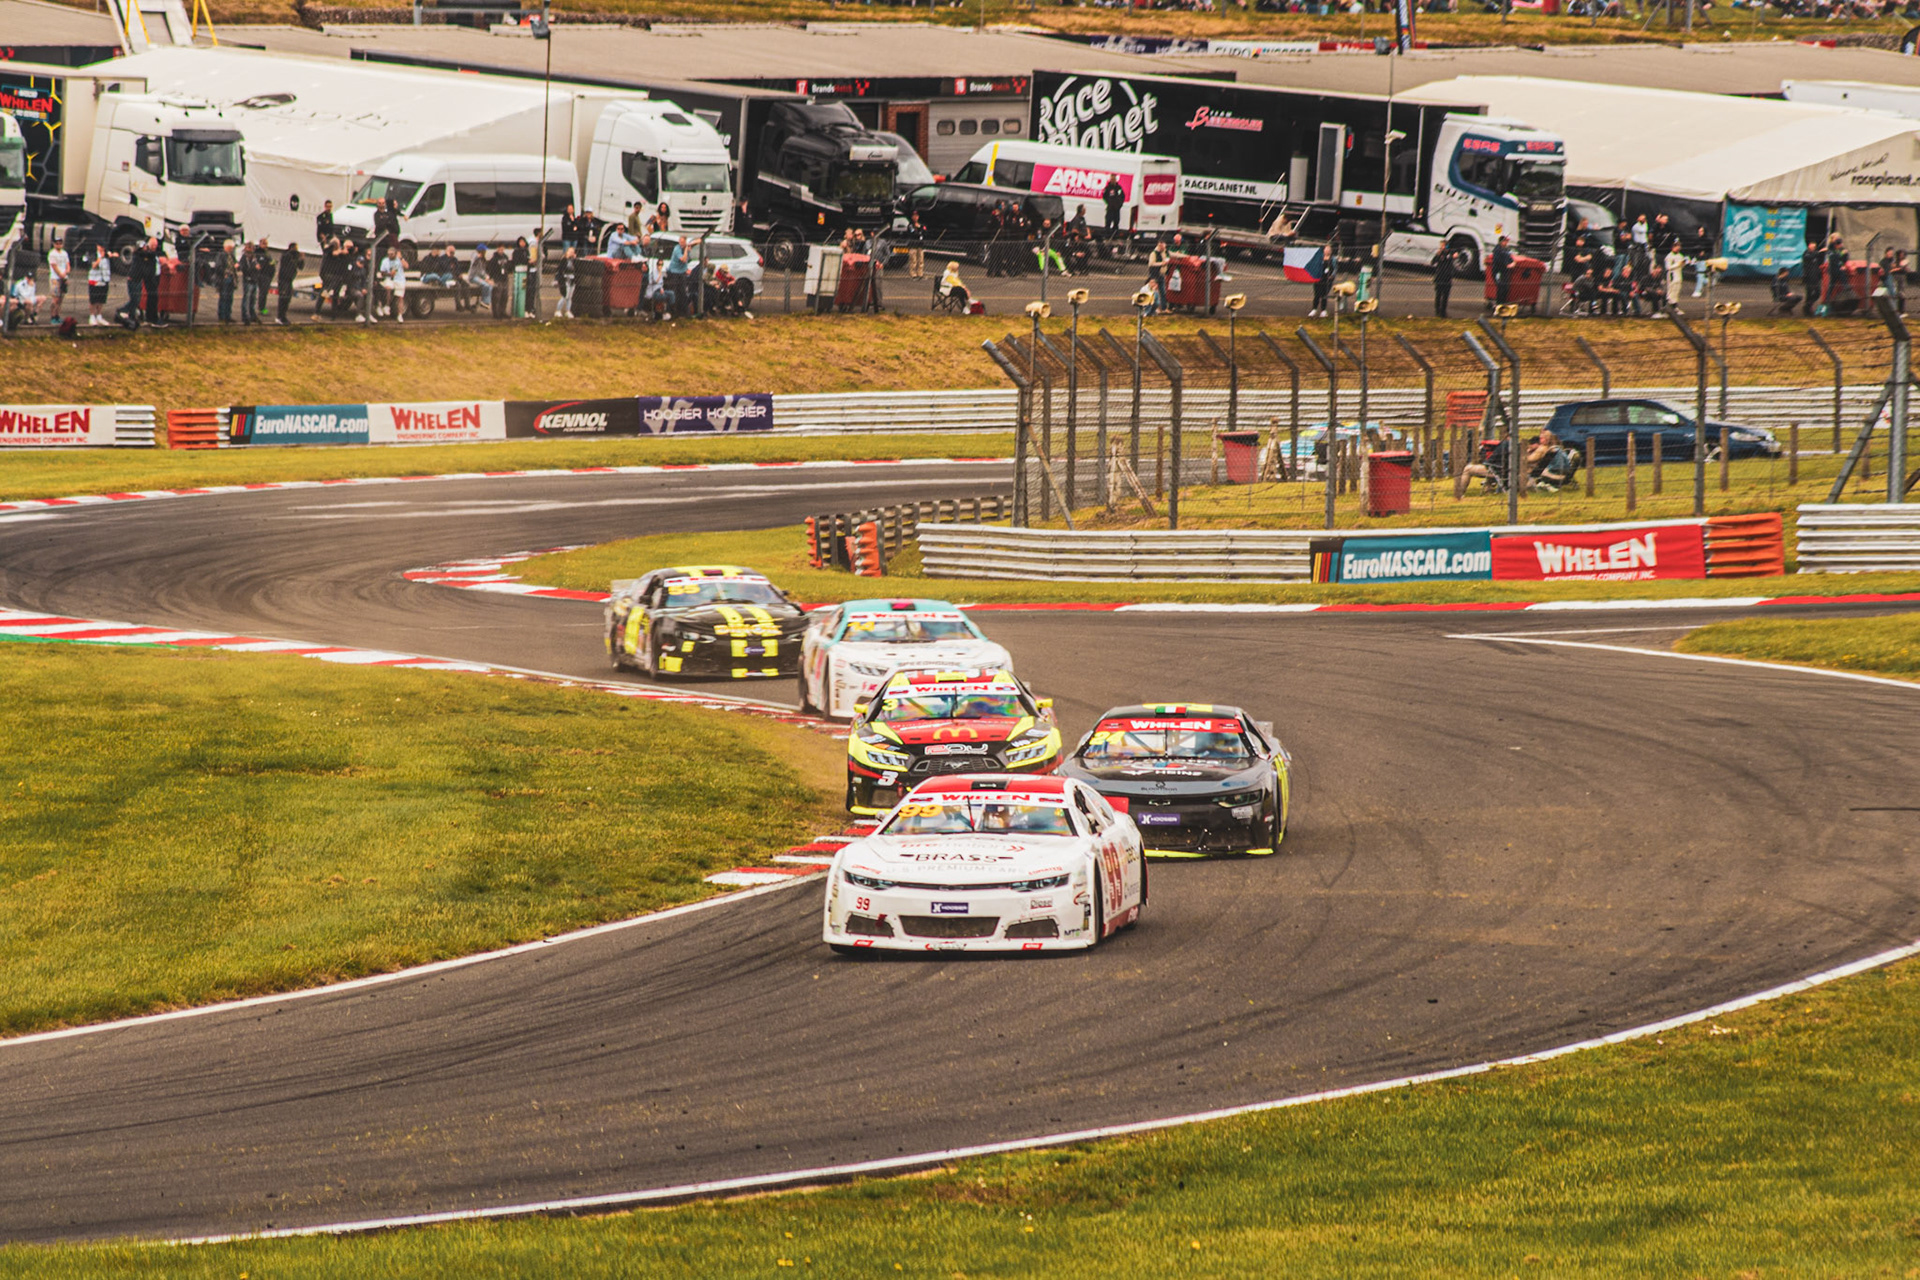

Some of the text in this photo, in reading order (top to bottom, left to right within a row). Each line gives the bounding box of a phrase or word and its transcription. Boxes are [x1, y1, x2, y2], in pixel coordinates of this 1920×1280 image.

[1038, 79, 1112, 142] Race
[1184, 179, 1258, 195] RACEPLANET.NL
[390, 404, 481, 430] WHELEN
[644, 408, 702, 421] HOOSIER
[706, 405, 767, 419] HOOSIER
[0, 408, 90, 433] WHELEN
[255, 414, 368, 434] EuroNASCAR.com
[538, 412, 608, 429] KENNOL
[1533, 532, 1657, 574] WHELEN
[1342, 548, 1491, 580] EuroNASCAR.com
[1597, 572, 1638, 581] COMPANY
[915, 685, 989, 694] WHELEN
[882, 699, 899, 711] 3
[1130, 719, 1212, 731] WHELEN
[878, 771, 899, 787] 3
[898, 804, 943, 817] 99
[915, 853, 998, 862] BRASS
[855, 896, 871, 911] 99
